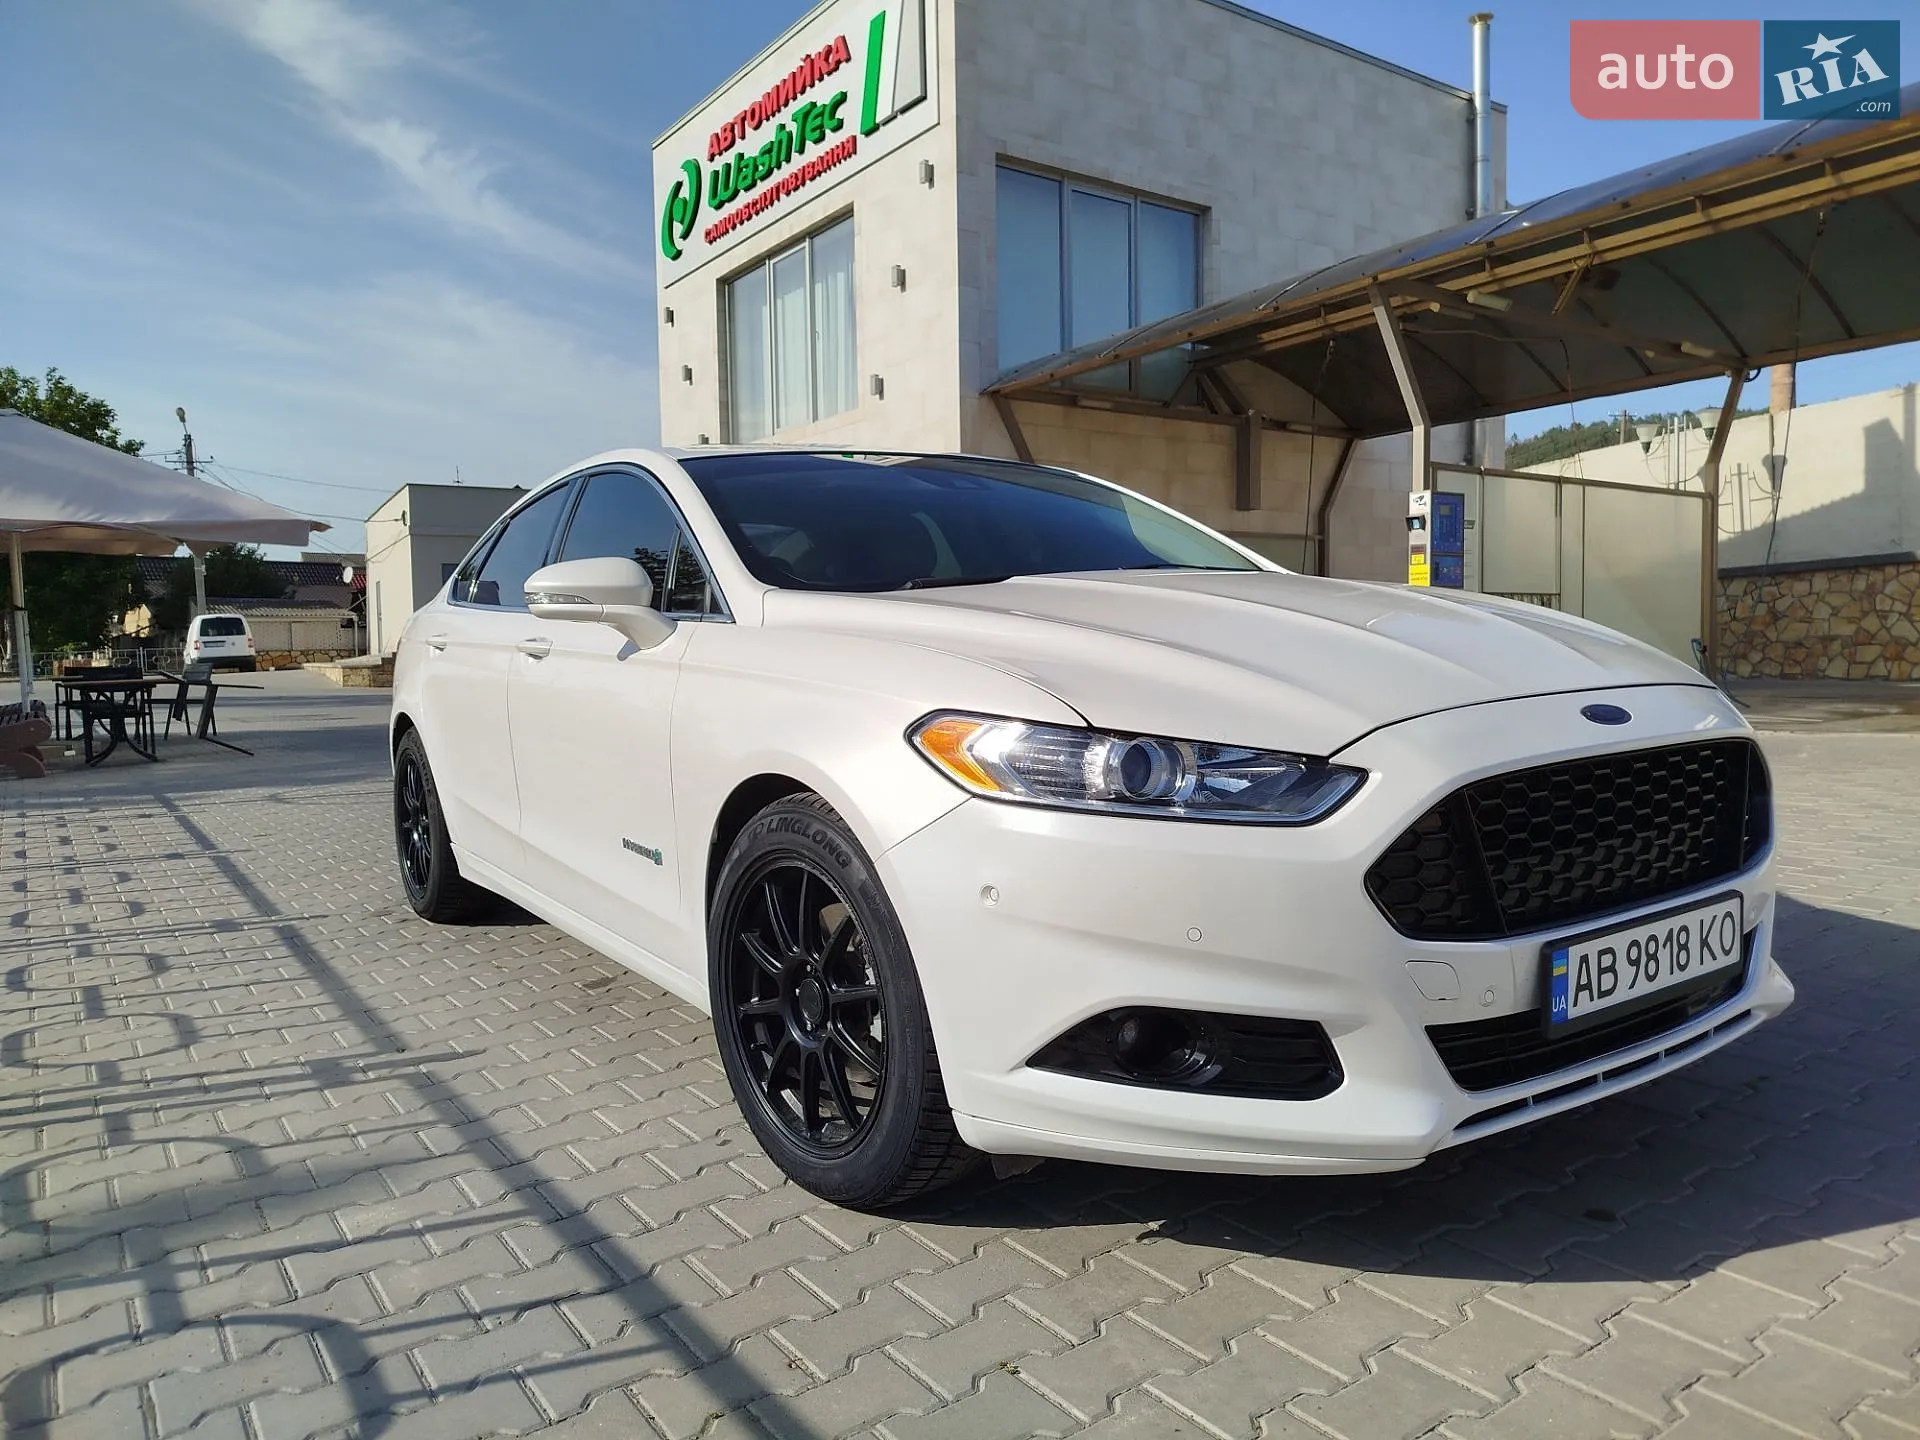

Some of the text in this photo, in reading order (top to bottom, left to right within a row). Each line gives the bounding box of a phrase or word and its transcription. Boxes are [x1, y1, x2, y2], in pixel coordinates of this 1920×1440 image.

[707, 34, 851, 161] АВТОМИЙКА
[704, 134, 857, 244] САМООБСЛУГОВУВАННЯ
[766, 816, 852, 870] LINGLONG
[1552, 994, 1567, 1013] UA
[1572, 910, 1736, 1008] AB 9818 KO
